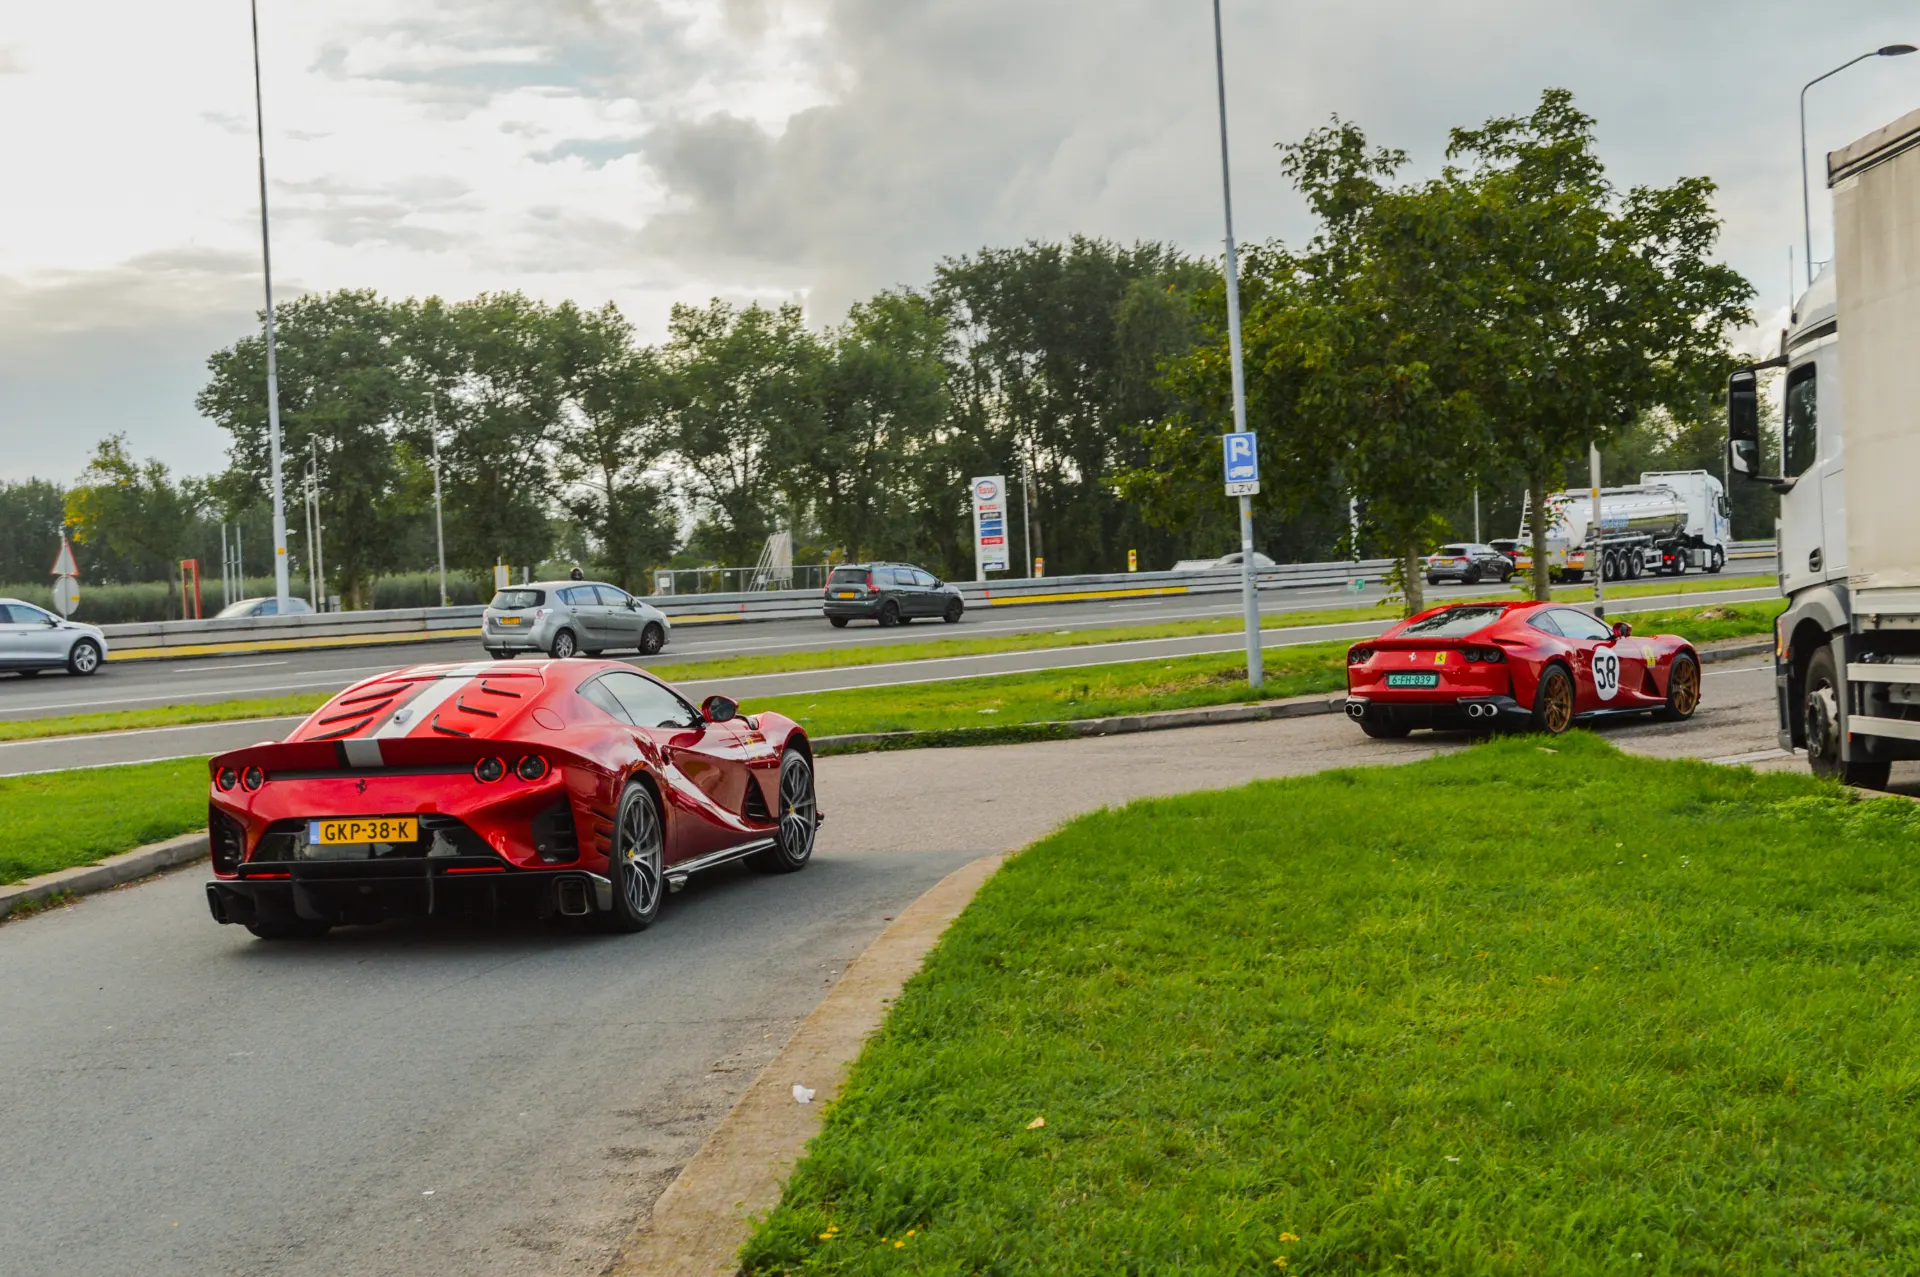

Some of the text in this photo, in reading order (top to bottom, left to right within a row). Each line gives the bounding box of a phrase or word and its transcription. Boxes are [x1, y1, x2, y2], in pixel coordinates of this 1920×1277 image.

[1232, 483, 1253, 494] LZV
[1392, 675, 1431, 685] 6-FH-839
[1594, 655, 1616, 690] 58
[324, 821, 409, 841] GKP-38-K
